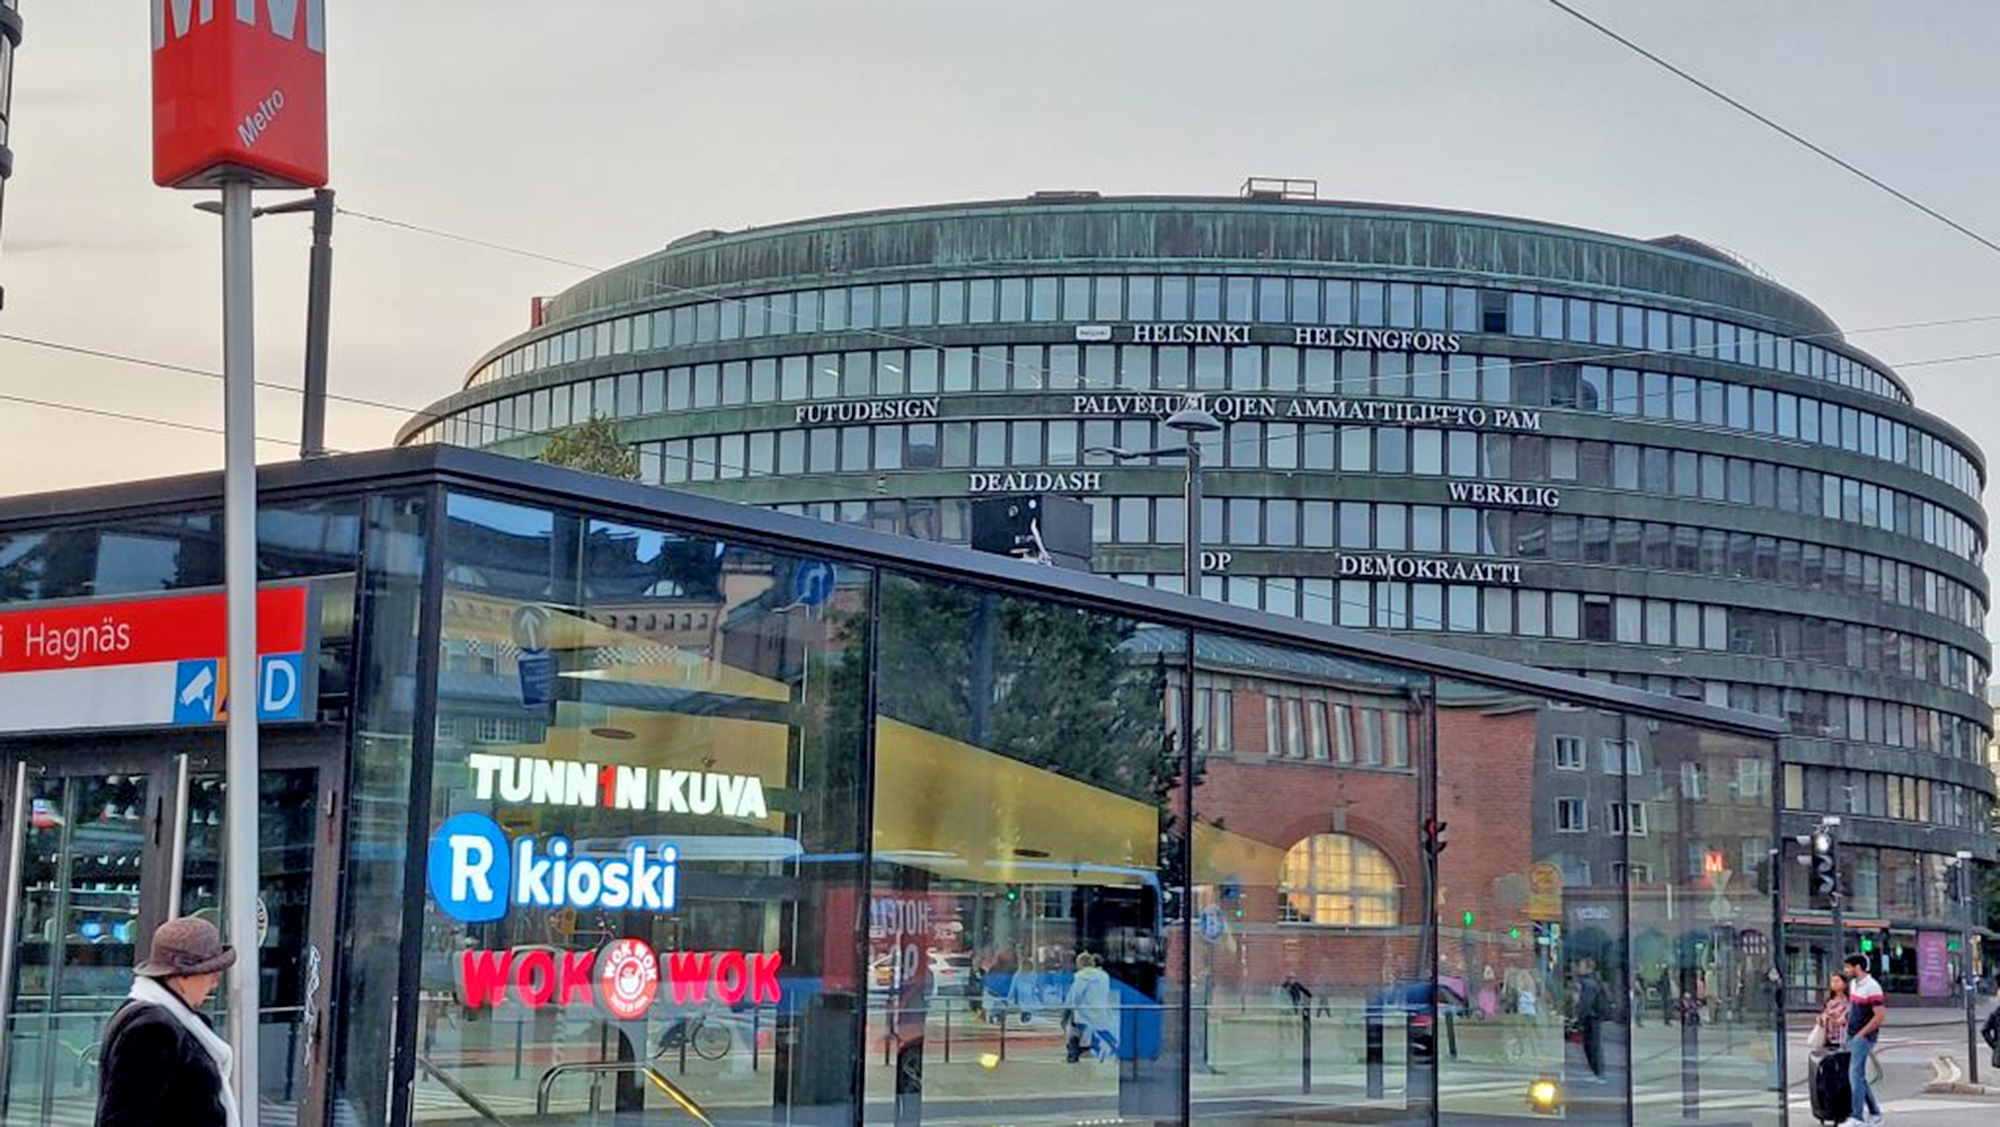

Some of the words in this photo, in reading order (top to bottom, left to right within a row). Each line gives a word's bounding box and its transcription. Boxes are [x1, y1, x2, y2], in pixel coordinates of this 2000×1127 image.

[237, 89, 284, 148] Metro
[1132, 323, 1251, 344] HELSINKI
[1294, 326, 1461, 353] HELSINGFORS
[794, 398, 940, 424] FUTUDESIGN
[1073, 395, 1276, 421] PALVELULOJEN
[1493, 408, 1542, 431] PAM
[968, 471, 1102, 492] DEALDASH
[1448, 482, 1561, 508] WERKLIG
[1200, 551, 1232, 571] DP
[1339, 554, 1522, 584] DEMOKRAATTI
[25, 616, 131, 662] Hagnäs
[656, 768, 768, 819] KUVA
[449, 834, 494, 903] R
[516, 839, 676, 909] kioski
[461, 949, 596, 1009] WOK
[669, 950, 782, 1005] WOK
[603, 941, 632, 978] WOK
[635, 942, 658, 982] WOK
